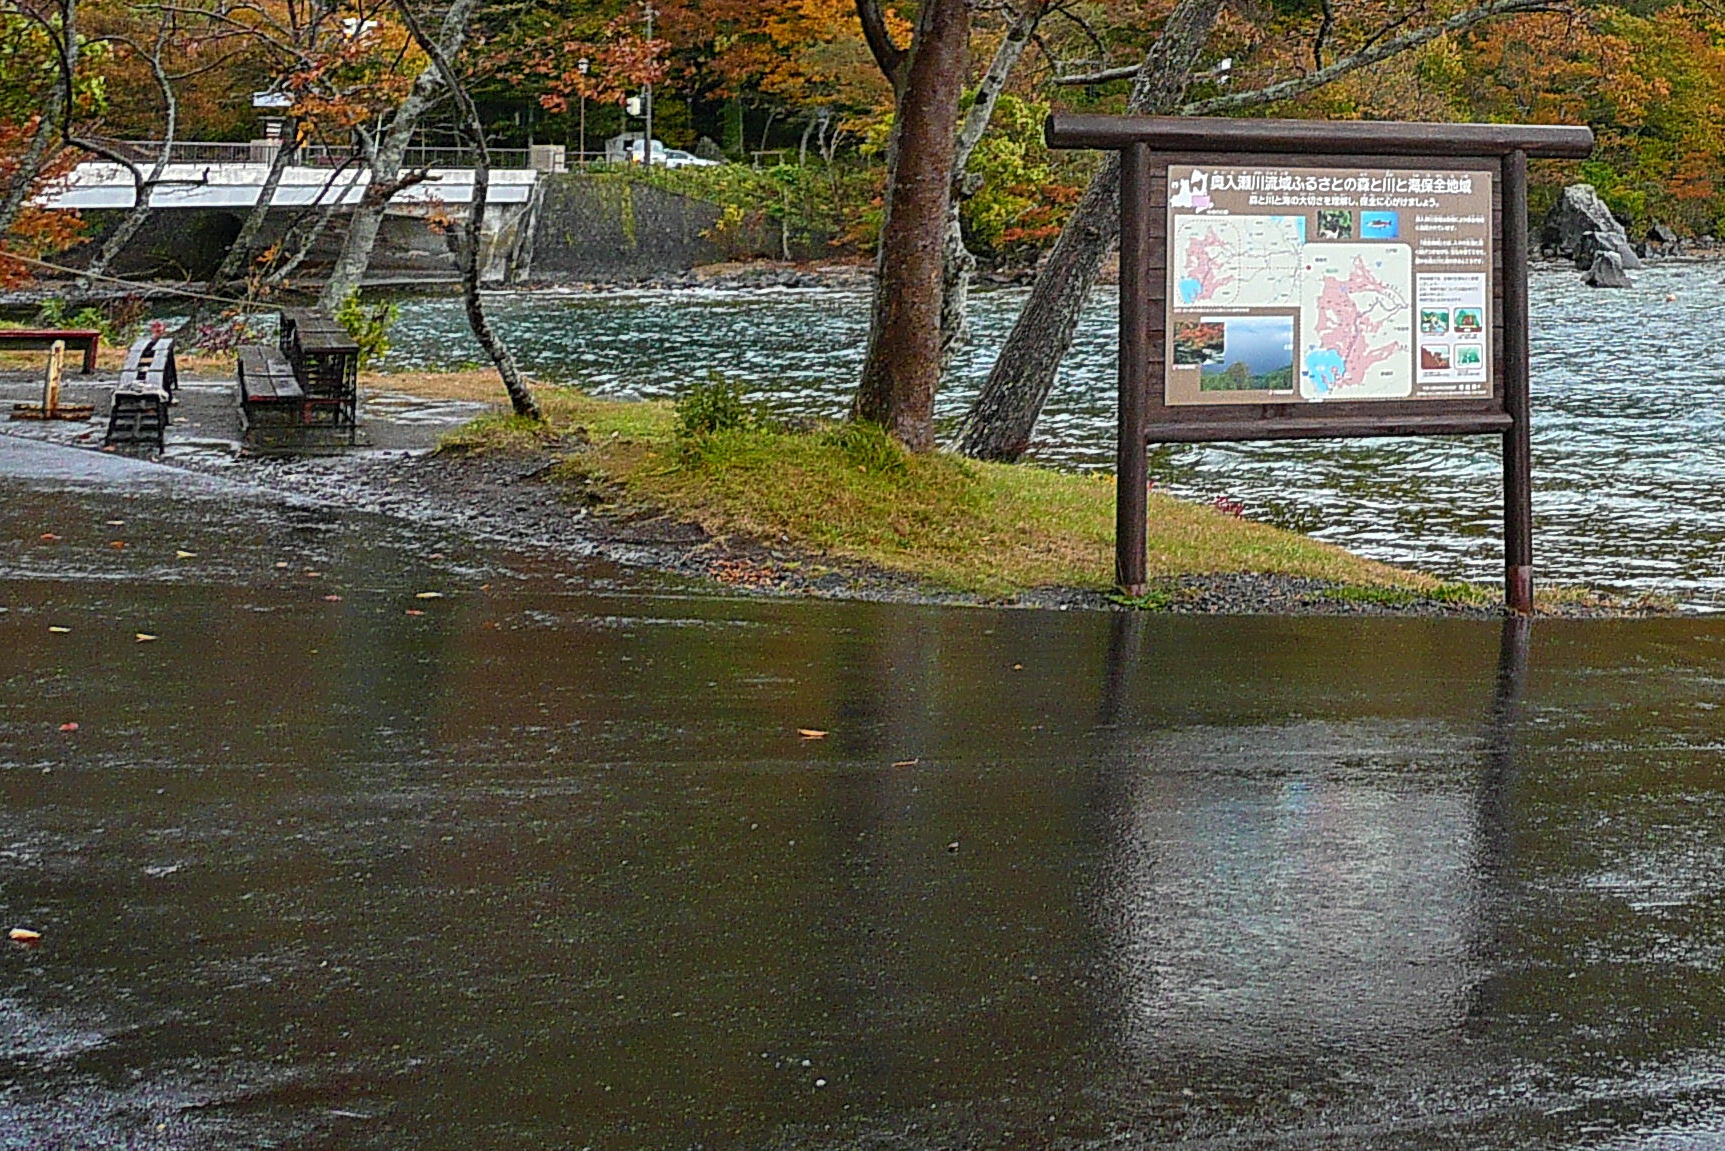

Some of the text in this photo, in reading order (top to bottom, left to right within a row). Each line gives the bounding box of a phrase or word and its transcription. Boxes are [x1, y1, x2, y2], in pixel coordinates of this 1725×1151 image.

[1210, 174, 1472, 194] 奥入瀬川流域ふるさとの森と川と海保全地域
